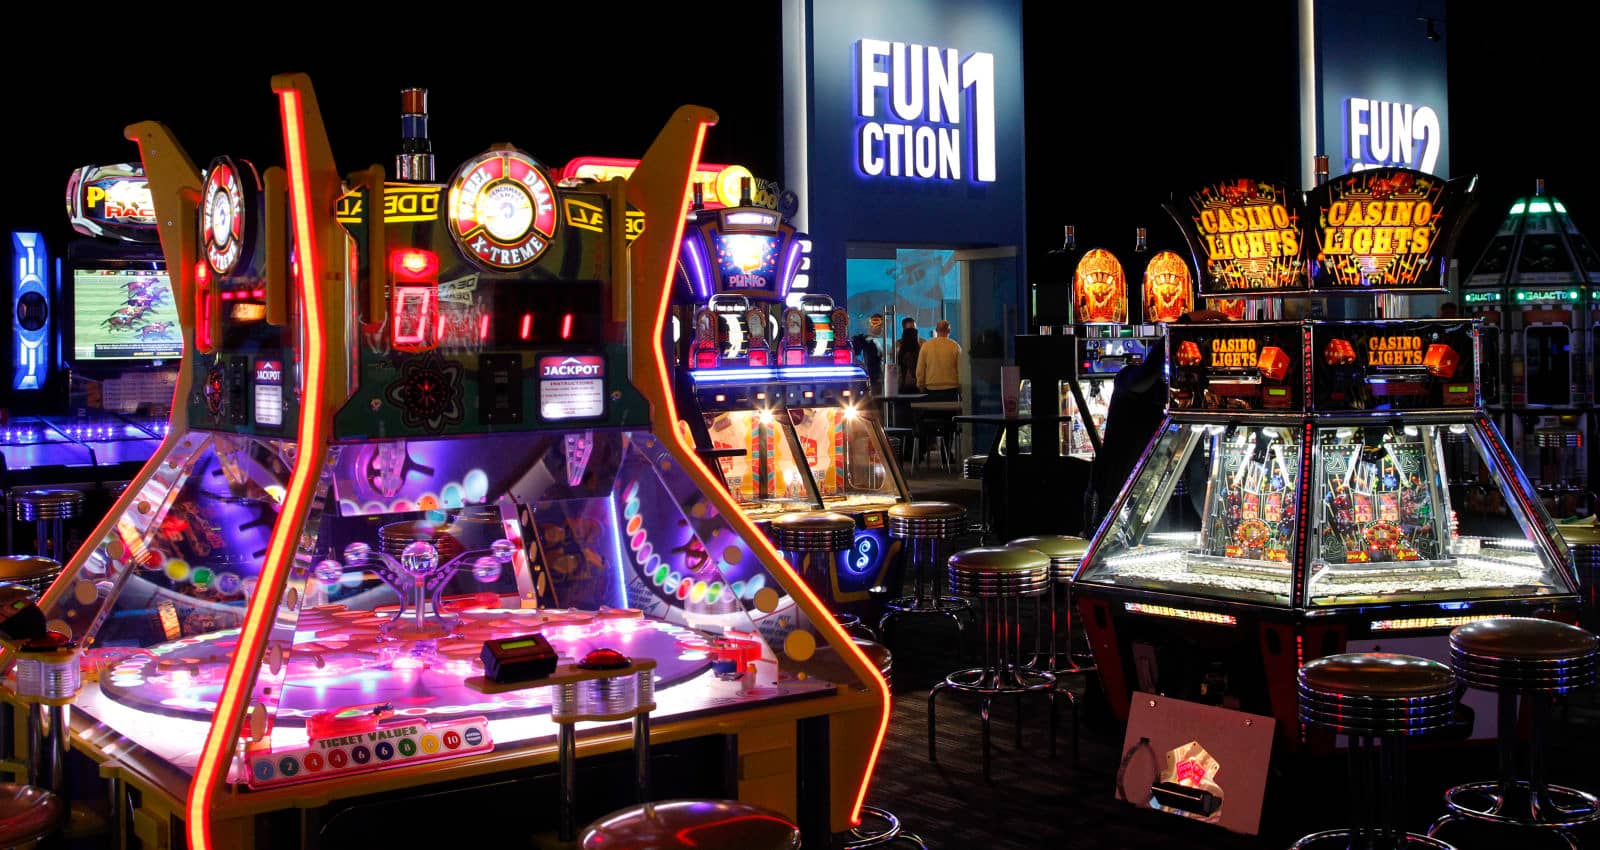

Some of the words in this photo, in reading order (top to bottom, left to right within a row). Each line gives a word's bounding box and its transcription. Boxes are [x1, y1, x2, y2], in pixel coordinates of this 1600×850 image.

[859, 38, 960, 124] FUN
[962, 52, 996, 182] 1
[1350, 97, 1412, 164] FUN
[1412, 106, 1440, 175] 2
[861, 121, 961, 180] CTION
[523, 169, 553, 216] DEAL
[106, 205, 156, 218] RAC
[1201, 203, 1289, 233] CASINO
[1327, 201, 1433, 227] CASINO
[471, 235, 543, 265] X-TREME
[1205, 229, 1299, 260] LIGHTS
[1323, 227, 1431, 254] LIGHTS
[729, 275, 766, 288] PLINKO
[1212, 339, 1257, 353] CASINO
[1368, 336, 1421, 350] CASINO
[1211, 353, 1258, 367] LIGHTS
[1368, 350, 1423, 366] LIGHTS
[256, 370, 281, 381] JACKPOT
[544, 365, 601, 376] JACKPOT
[319, 734, 364, 749] TICKET
[368, 726, 418, 741] VALUES
[447, 736, 459, 745] 10
